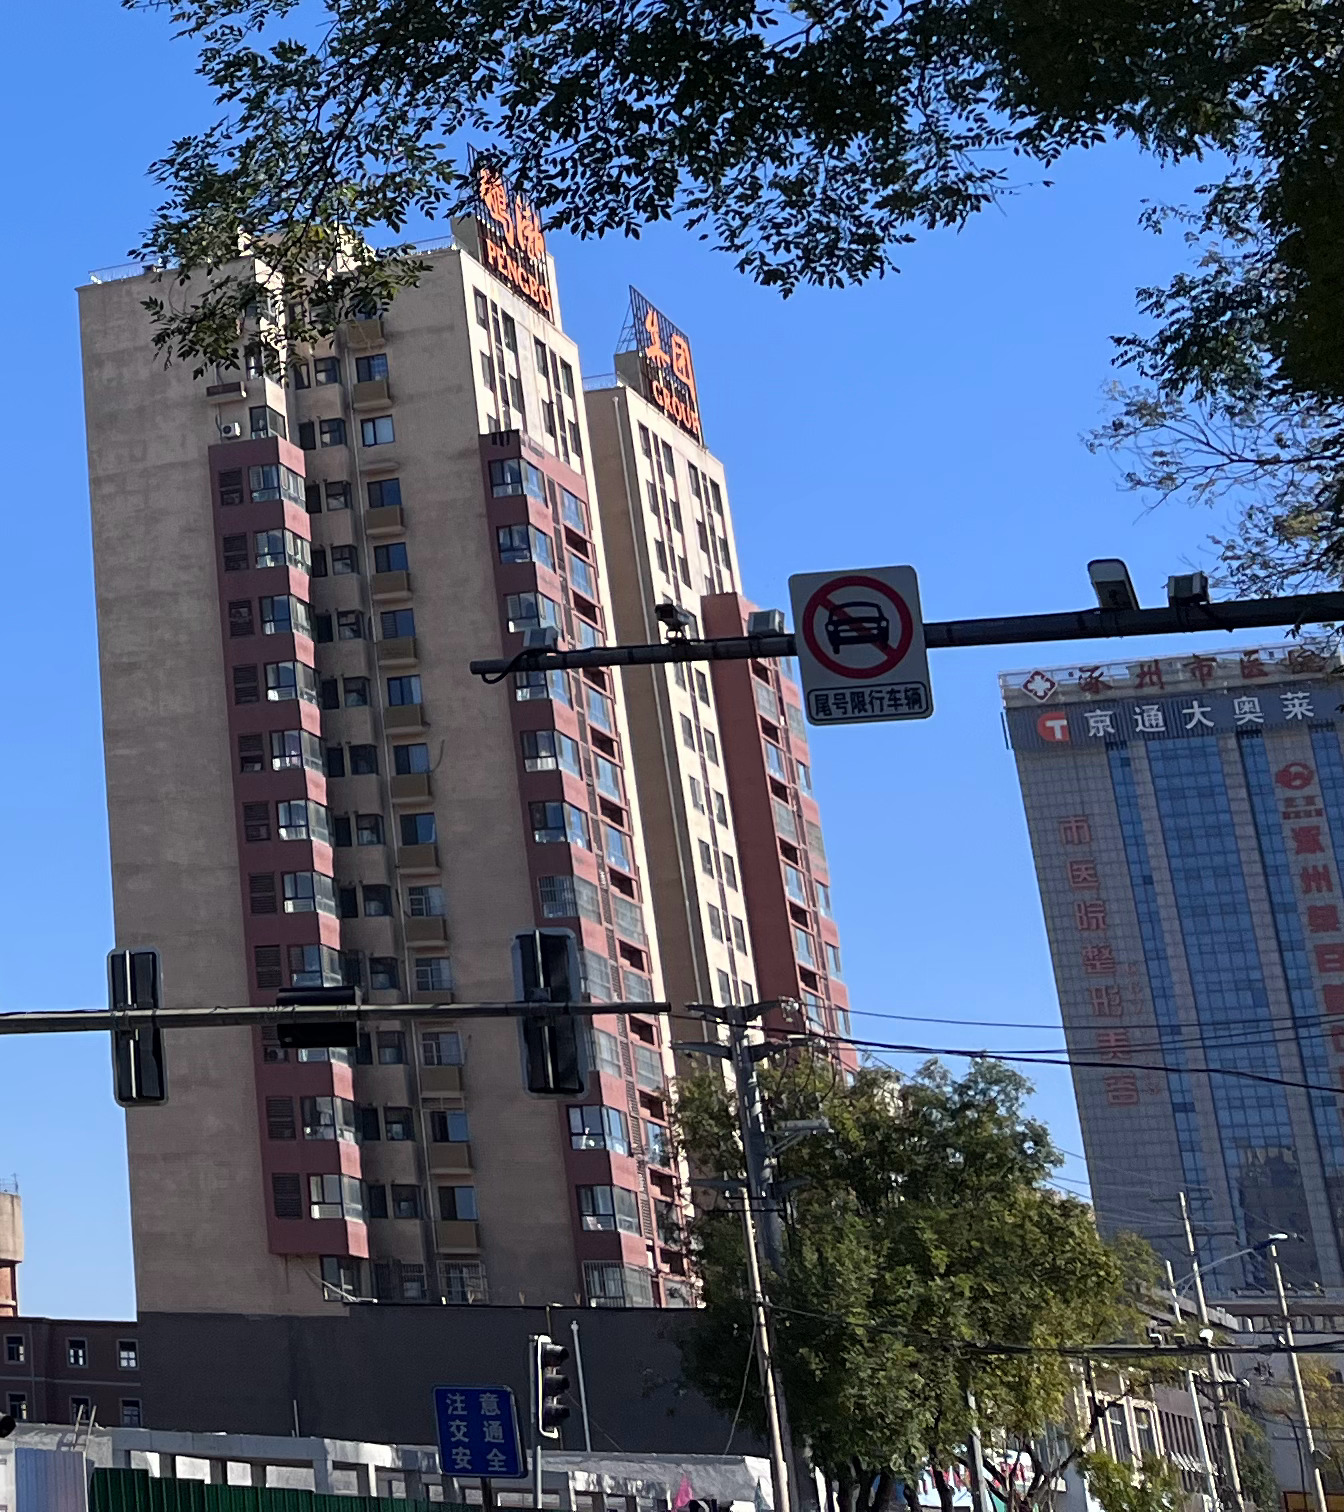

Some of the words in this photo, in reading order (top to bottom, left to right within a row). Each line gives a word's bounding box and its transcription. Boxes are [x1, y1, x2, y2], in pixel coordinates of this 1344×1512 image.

[486, 238, 551, 312] PENGBO
[645, 308, 695, 405] 集团
[652, 380, 699, 435] GROUP
[815, 687, 923, 717] 尾号限行车辆
[1084, 691, 1315, 737] 京通大奥莱
[1058, 813, 1140, 1107] 市医院整形美容
[446, 1392, 501, 1416] 注意
[449, 1419, 505, 1443] 交通
[451, 1447, 508, 1472] 安全
